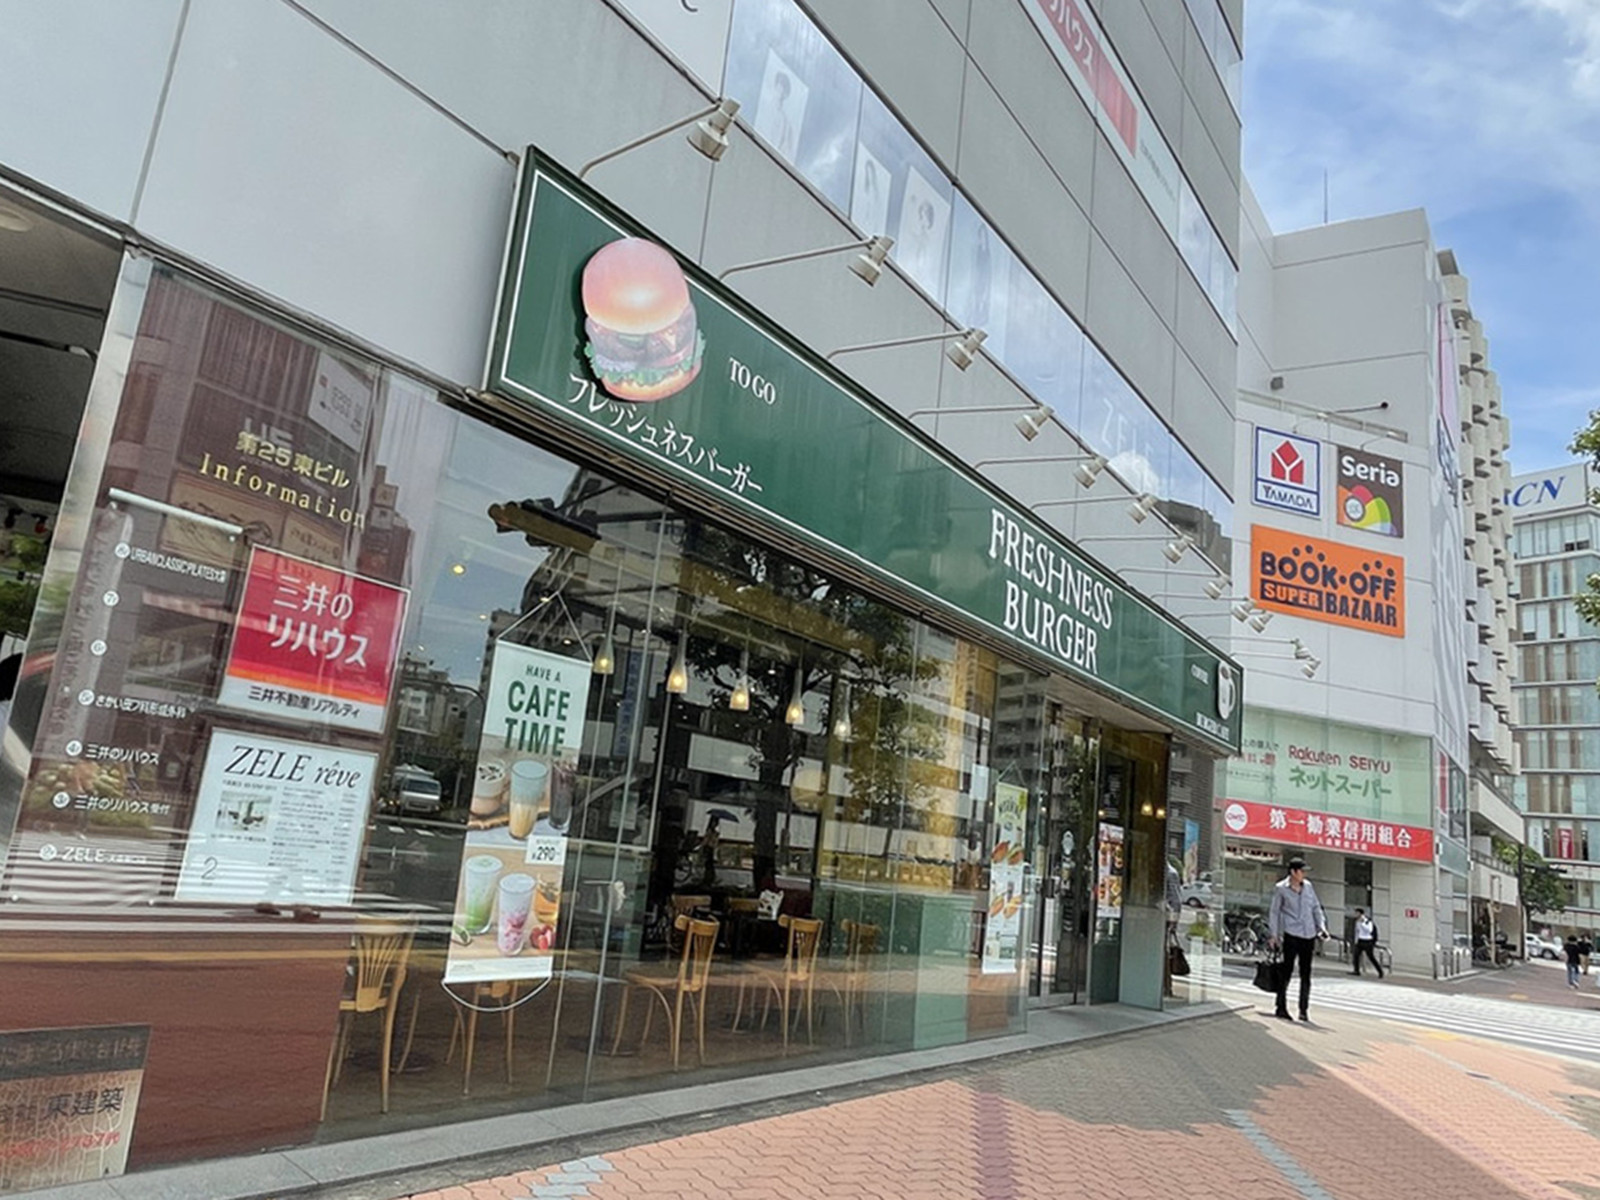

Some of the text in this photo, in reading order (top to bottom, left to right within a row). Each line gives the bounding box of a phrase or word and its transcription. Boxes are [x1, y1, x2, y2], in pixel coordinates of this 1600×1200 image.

[1050, 0, 1093, 76] ハウス
[728, 357, 776, 405] TO GO
[568, 373, 763, 493] フレッシュネスバーガー
[235, 430, 350, 488] 第25東ビル
[1341, 455, 1400, 487] Seria
[200, 452, 365, 532] Information
[1262, 485, 1314, 509] YAMADA
[988, 508, 1114, 629] FRESHNESS
[273, 574, 354, 620] 三井の
[1264, 583, 1397, 627] SUPER BAZAAR
[267, 613, 368, 668] リハウス
[1004, 579, 1098, 675] BURGER
[526, 665, 561, 683] HAVE A
[508, 680, 571, 721] CAFE
[505, 717, 565, 757] TIME
[1288, 744, 1342, 766] Rakuten
[1349, 755, 1391, 774] SEIYU
[224, 745, 361, 789] ZELE rêve
[1289, 766, 1392, 799] ネットスーパー
